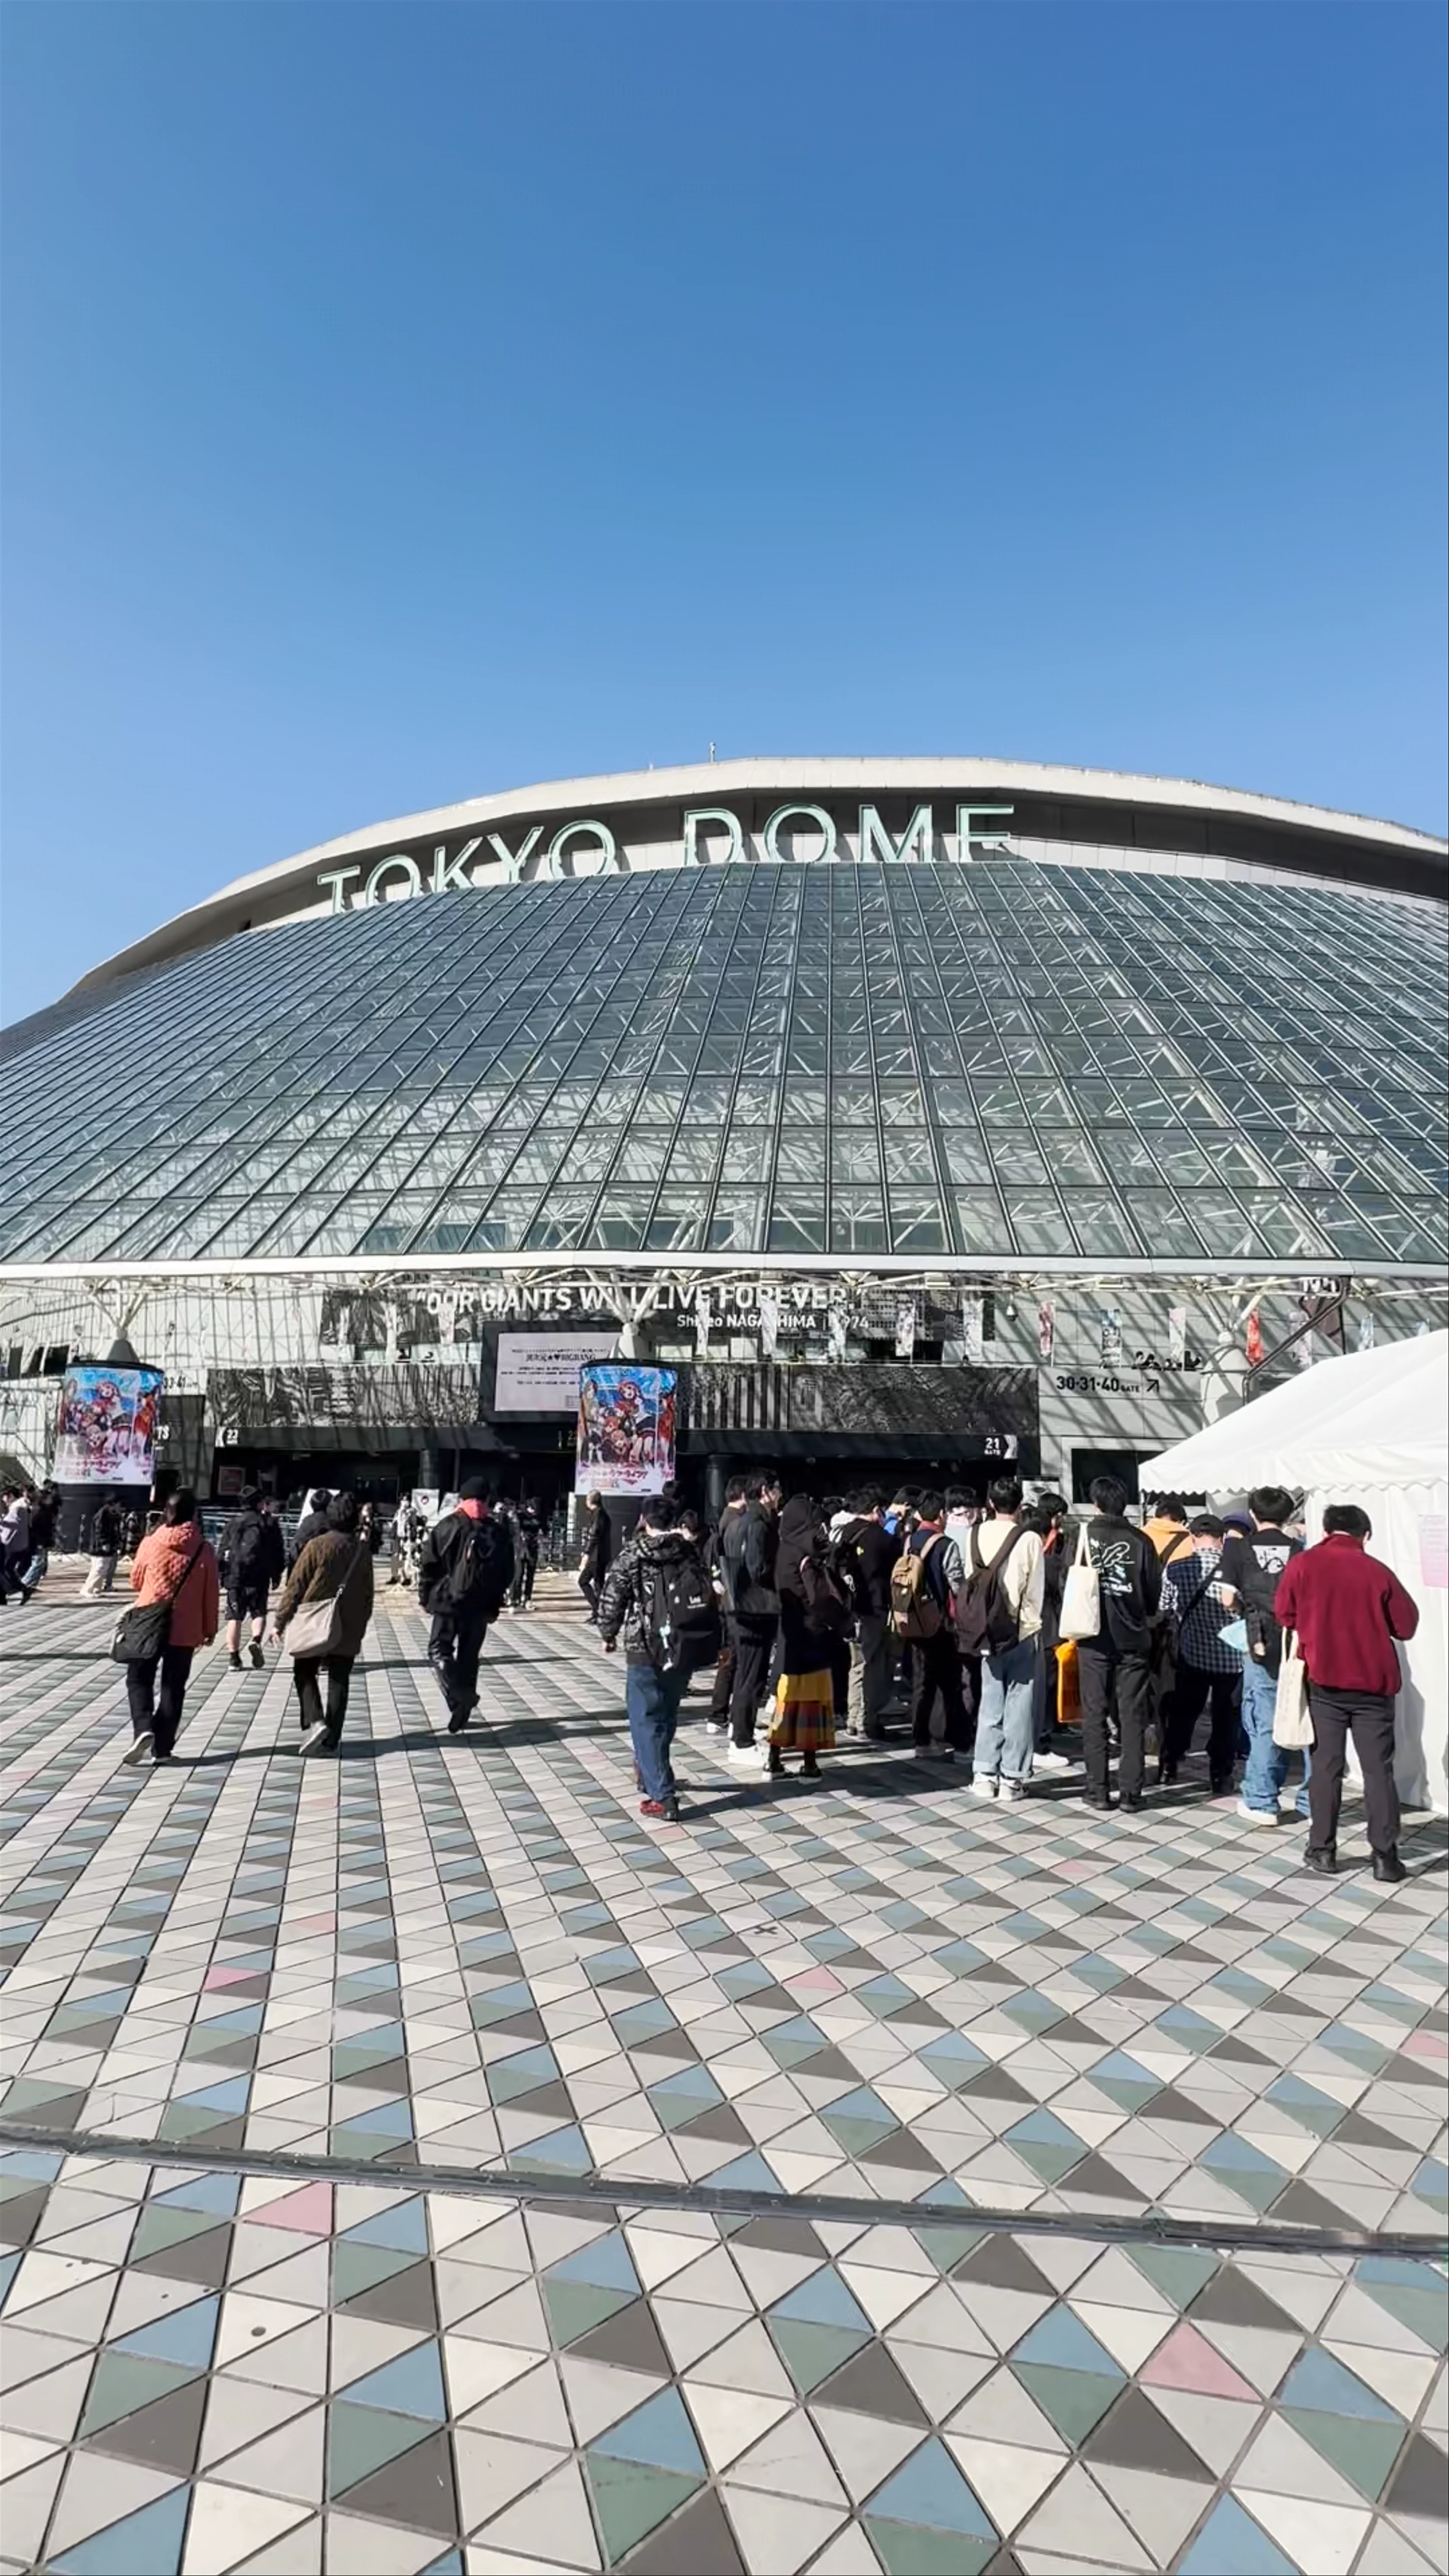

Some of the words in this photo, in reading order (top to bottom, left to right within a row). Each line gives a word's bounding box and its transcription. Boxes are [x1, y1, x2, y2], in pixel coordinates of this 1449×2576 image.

[317, 819, 617, 913] TOKYO
[684, 804, 1015, 866] DOME
[481, 1286, 572, 1312] GIANTS
[985, 1436, 1000, 1449] 21
